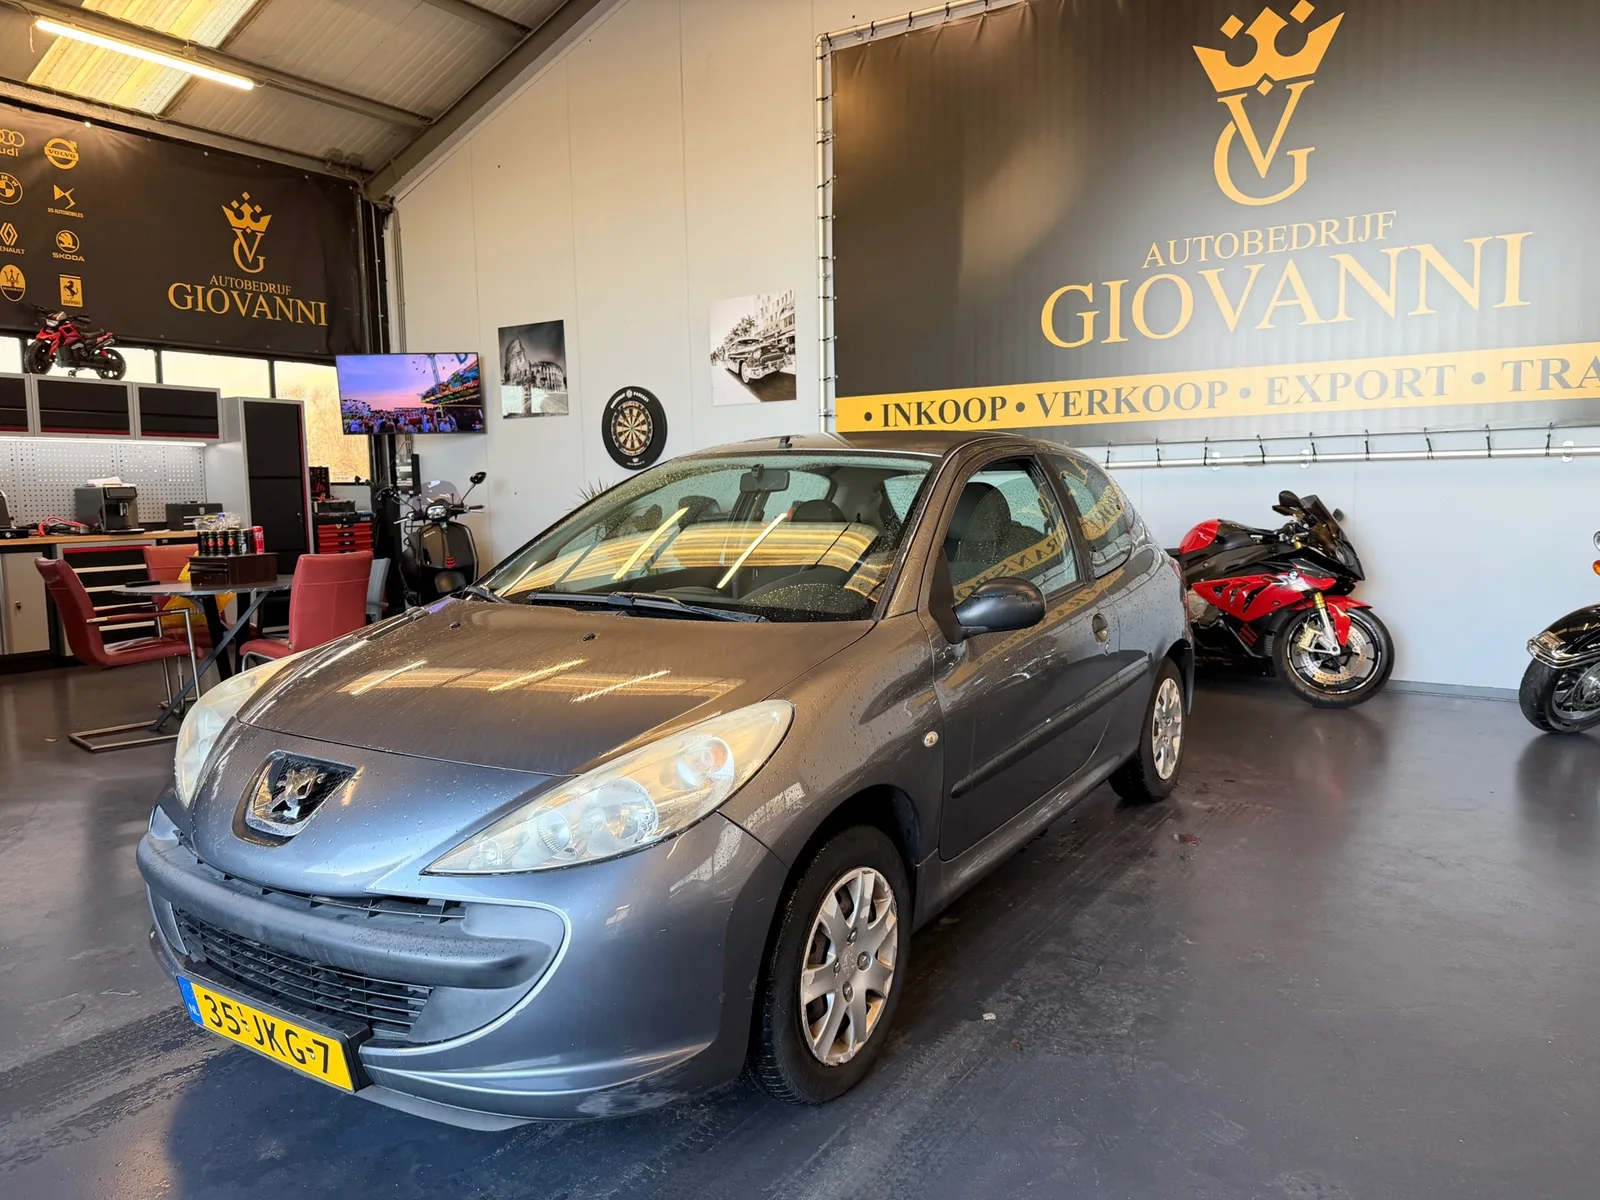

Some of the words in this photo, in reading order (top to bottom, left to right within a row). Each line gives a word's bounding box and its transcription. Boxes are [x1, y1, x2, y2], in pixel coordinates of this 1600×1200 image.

[47, 149, 76, 159] VOLVO
[1141, 211, 1397, 269] AUTOBEDRIJF
[168, 282, 328, 327] GIOVANNI
[209, 275, 292, 296] AUTOBEDRIJF
[1041, 231, 1534, 348] GIOVANNI
[881, 396, 1007, 428] INKOOP
[1035, 380, 1229, 419] VERKOOP
[1264, 364, 1457, 406] EXPORT
[188, 1003, 200, 1017] NL
[203, 994, 330, 1074] 35-JKG-7
